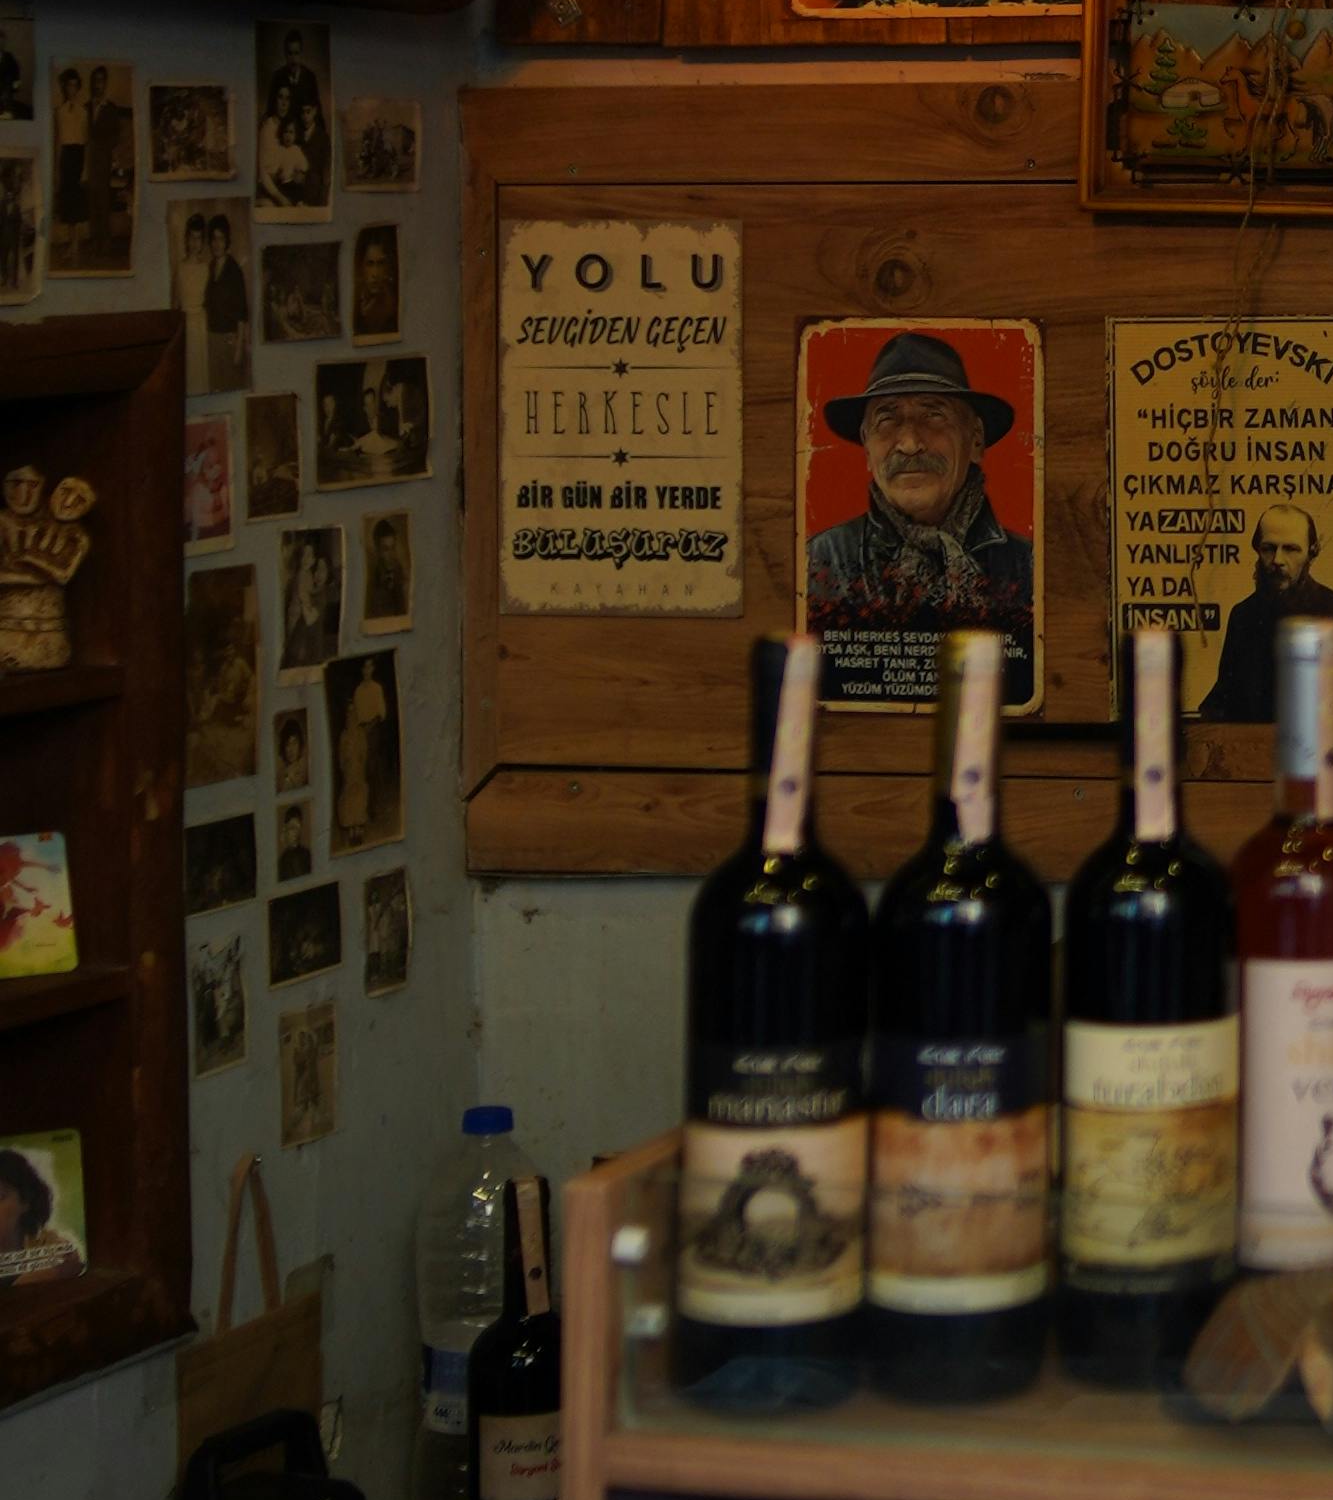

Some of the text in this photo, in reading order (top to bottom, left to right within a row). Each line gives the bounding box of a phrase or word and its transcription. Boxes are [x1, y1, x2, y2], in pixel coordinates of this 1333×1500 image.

[520, 253, 724, 292] YOLU
[516, 309, 727, 354] SEVGİDEN GEÇEN
[1191, 366, 1238, 399] şöyle
[525, 390, 719, 435] HERKESLE
[1137, 402, 1235, 431] "HİÇBİR
[1148, 436, 1326, 462] DOĞRU İNSAN
[516, 480, 722, 510] BİR GÜN BİR YERDE
[1123, 474, 1222, 500] ÇIKMAZ
[1126, 511, 1244, 532] YA ZAMAN
[1126, 543, 1241, 569] YANLIŞTIR
[549, 582, 697, 597] KAYAHAN
[1127, 577, 1193, 597] YA DA
[823, 628, 900, 643] BENİ HERKES
[874, 642, 901, 656] BENİ
[834, 657, 879, 670] HASRET
[883, 657, 921, 671] TANIR,
[882, 669, 916, 683] ÖLÜM
[841, 681, 881, 695] YÜZÜM
